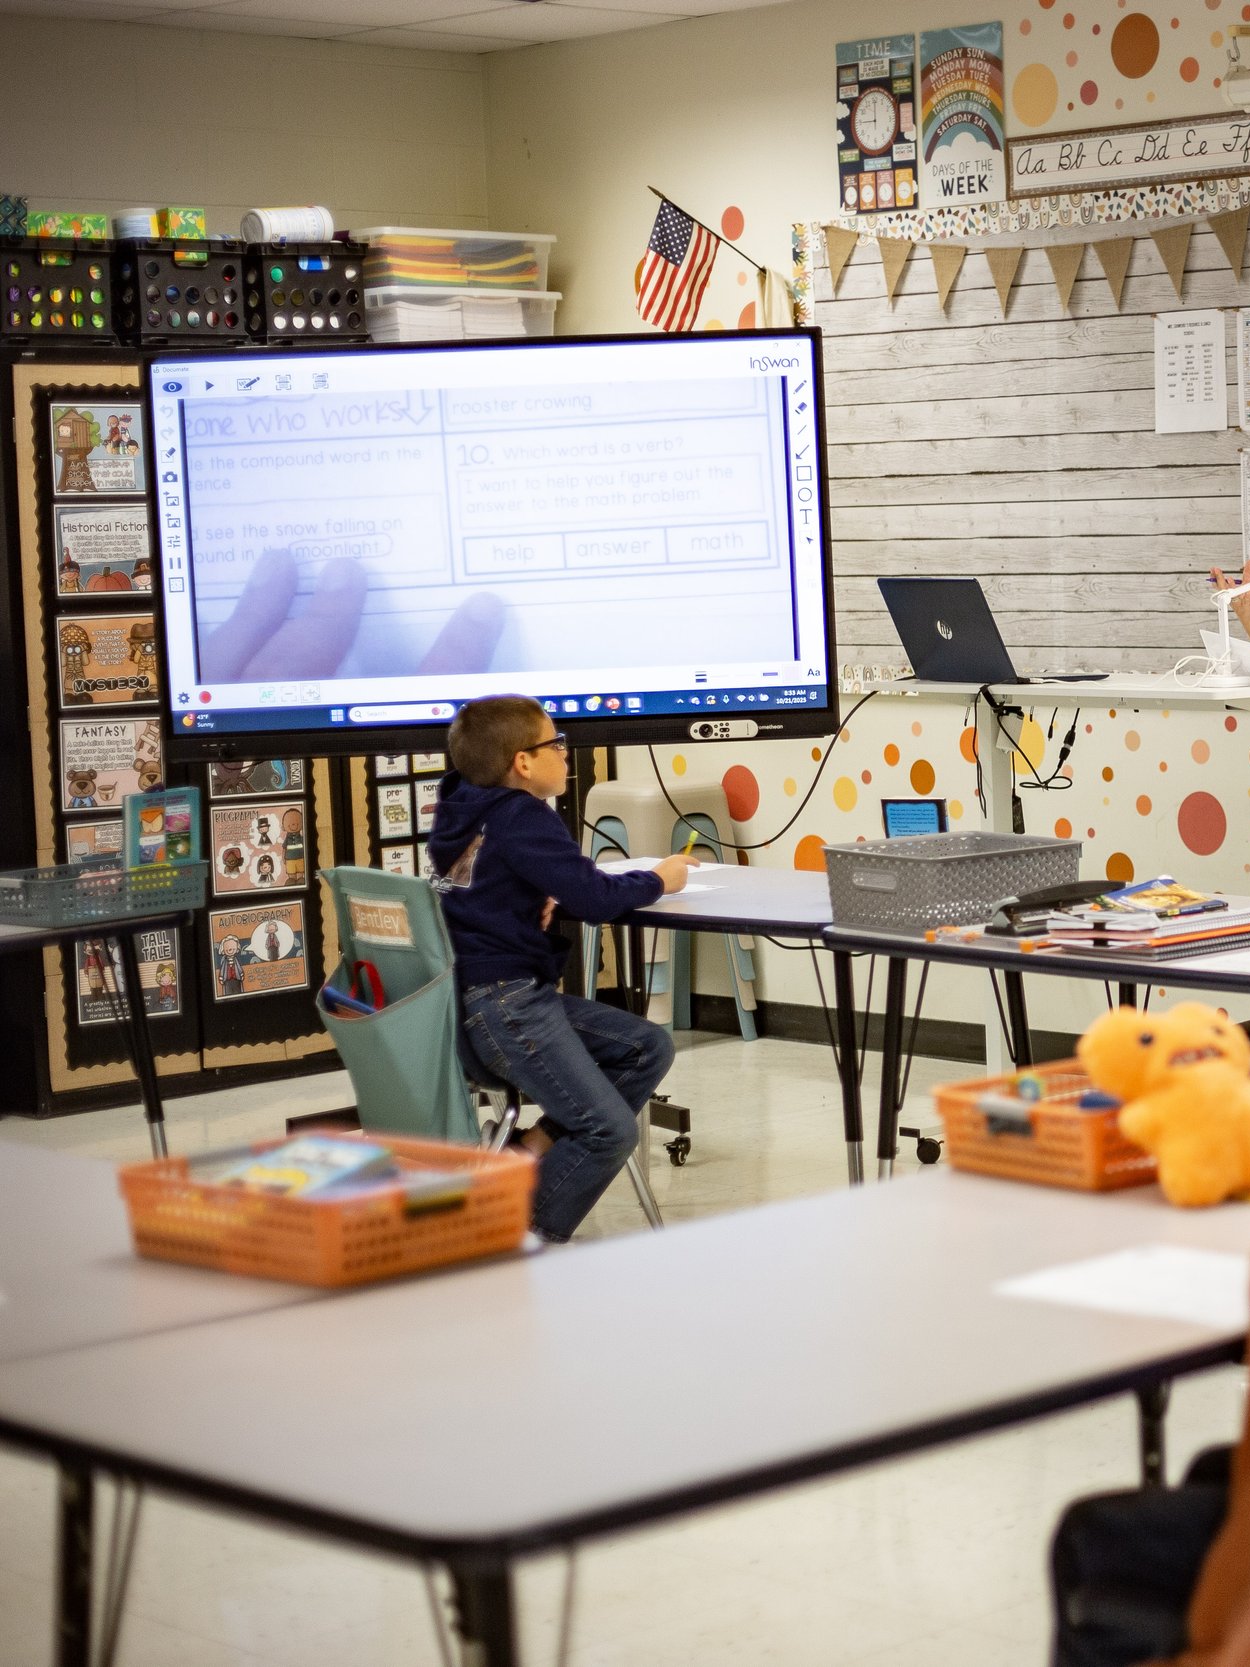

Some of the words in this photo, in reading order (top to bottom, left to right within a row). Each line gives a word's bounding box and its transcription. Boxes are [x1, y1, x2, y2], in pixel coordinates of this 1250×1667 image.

[857, 40, 892, 58] TIME
[930, 48, 963, 70] SUNDAY
[929, 58, 966, 83] MONDAY
[931, 70, 967, 92] TUESDAY
[932, 92, 967, 115] THURSDAY
[936, 112, 973, 136] SATURDAY
[1016, 148, 1047, 176] Aa
[1058, 144, 1086, 171] Bb
[1097, 139, 1123, 166] Cc
[1135, 134, 1169, 163] Dd
[1182, 129, 1208, 157] Ee
[932, 162, 956, 177] DAYS
[958, 160, 971, 174] OF
[974, 158, 993, 172] THE
[941, 174, 989, 197] WEEK
[451, 398, 517, 415] rooster
[524, 394, 592, 412] crowing
[208, 456, 235, 470] the
[240, 447, 325, 471] compound
[329, 448, 372, 463] word
[376, 449, 390, 460] in
[394, 447, 422, 460] the
[457, 443, 495, 467] 10.
[502, 445, 551, 461] Which
[555, 443, 598, 458] word
[637, 436, 684, 454] verb?
[478, 476, 517, 492] want
[546, 474, 580, 491] help
[585, 473, 615, 489] you
[620, 469, 668, 486] figure
[673, 466, 702, 481] out
[707, 465, 733, 480] the
[466, 499, 524, 514] answer
[554, 494, 579, 509] the
[585, 491, 627, 507] math
[62, 521, 112, 534] Historical
[205, 526, 234, 541] see
[242, 523, 270, 540] the
[275, 521, 318, 537] snow
[324, 516, 376, 538] falling
[383, 518, 403, 532] on
[294, 539, 381, 562] moonlight
[576, 539, 652, 557] answer
[690, 532, 744, 551] math
[492, 544, 535, 562] help
[73, 677, 149, 692] MYSTERY
[75, 725, 127, 738] FANTASY
[196, 721, 215, 729] Sunny
[386, 788, 402, 799] pre-
[391, 851, 404, 860] de-
[218, 909, 293, 928] AUTOBIOGRAPHY
[353, 906, 400, 934] Bentley
[141, 930, 169, 947] TALL
[142, 944, 171, 962] TALE
